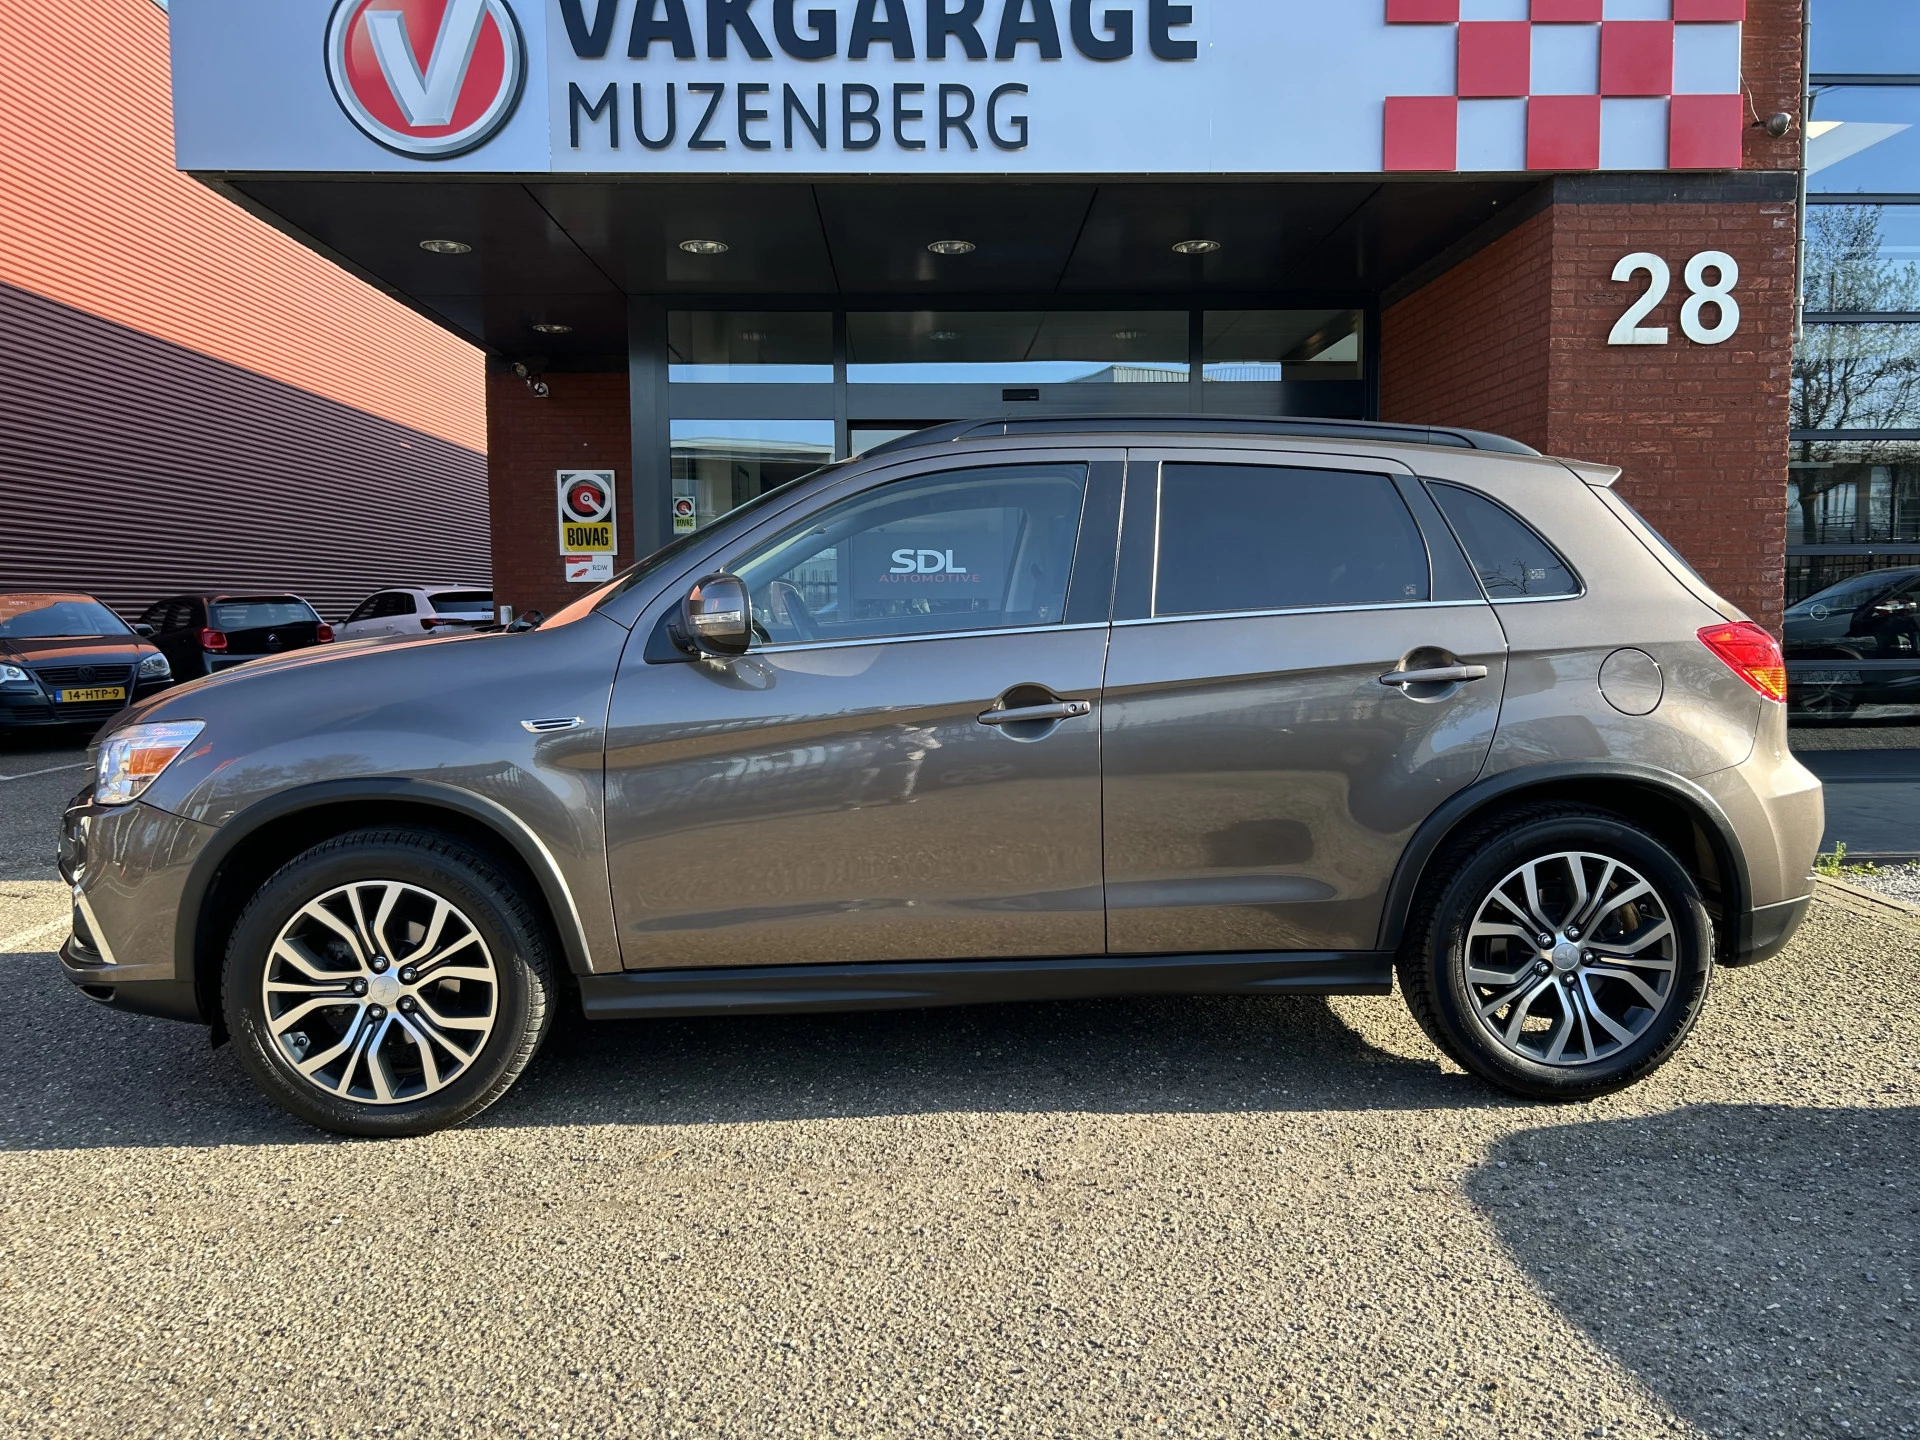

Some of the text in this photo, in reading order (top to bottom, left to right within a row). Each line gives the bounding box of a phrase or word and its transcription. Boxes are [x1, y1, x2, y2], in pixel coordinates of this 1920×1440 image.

[559, 0, 1197, 61] VAKGARAGE
[569, 82, 1029, 151] MUZENBERG
[1607, 250, 1740, 346] 28
[567, 527, 609, 546] BOVAG
[889, 548, 967, 574] SDL
[879, 574, 981, 583] AUTOMOTIVE
[68, 688, 120, 701] 14-HTP-9
